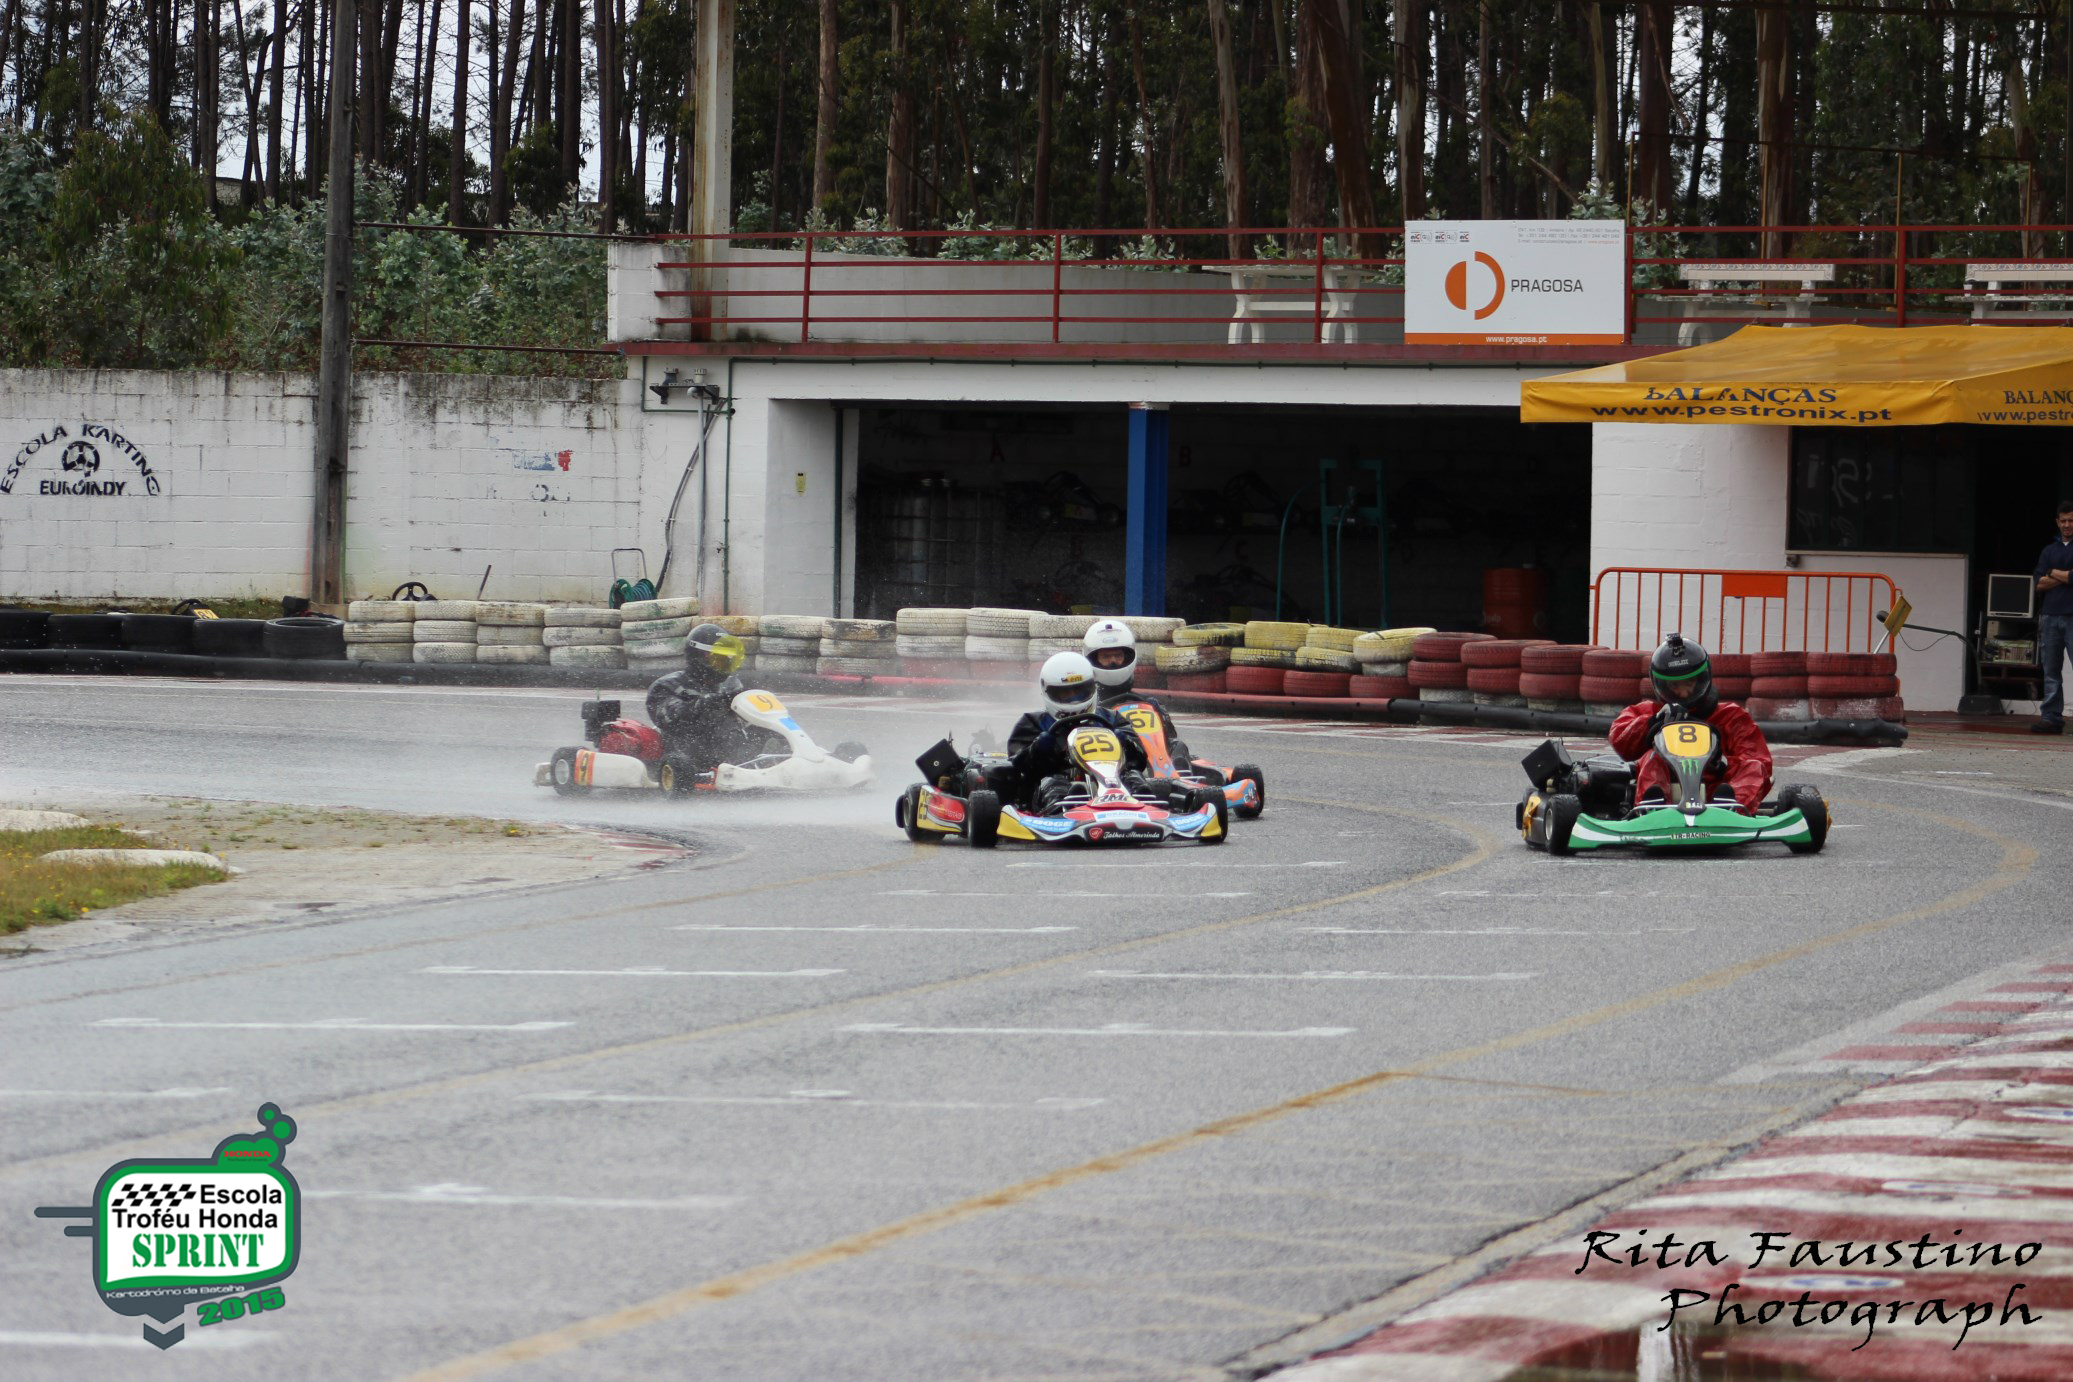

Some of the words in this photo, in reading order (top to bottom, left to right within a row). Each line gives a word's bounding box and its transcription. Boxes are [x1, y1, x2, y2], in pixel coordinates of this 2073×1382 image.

[1511, 278, 1584, 293] PRAGOSA
[1485, 335, 1548, 345] www.pragosa.pt
[1590, 404, 1893, 424] www.pestronix.pt
[1977, 408, 2073, 423] www.pestr
[0, 425, 68, 494] ESCOLA
[81, 423, 161, 497] KARTING
[39, 479, 127, 496] EUROINDY
[1125, 710, 1156, 729] 67
[1678, 725, 1698, 743] 8
[1077, 733, 1115, 756] 25
